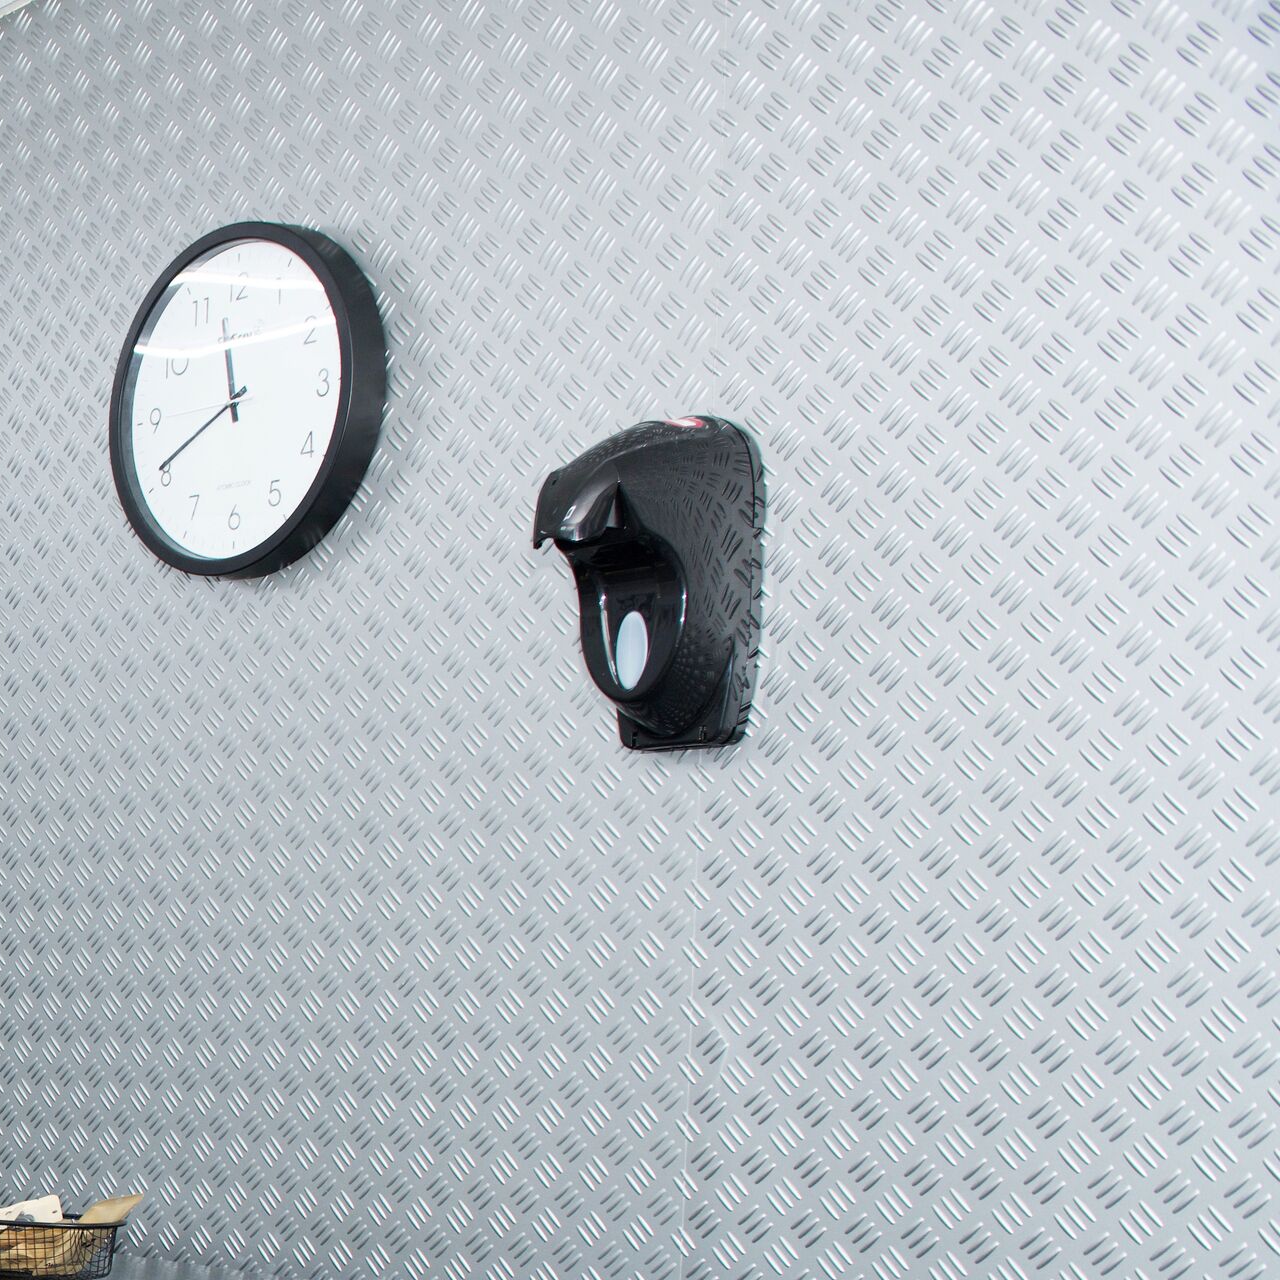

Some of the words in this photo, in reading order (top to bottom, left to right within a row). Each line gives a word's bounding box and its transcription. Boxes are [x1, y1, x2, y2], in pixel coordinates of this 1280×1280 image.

[228, 271, 248, 303] 12
[192, 296, 209, 328] 11
[303, 315, 318, 345] 2
[316, 368, 330, 398] 3
[149, 407, 162, 434] 9
[300, 431, 315, 458] 4
[159, 458, 172, 487] 8
[189, 494, 200, 520] 7
[268, 479, 282, 507] 5
[227, 504, 241, 530] 6
